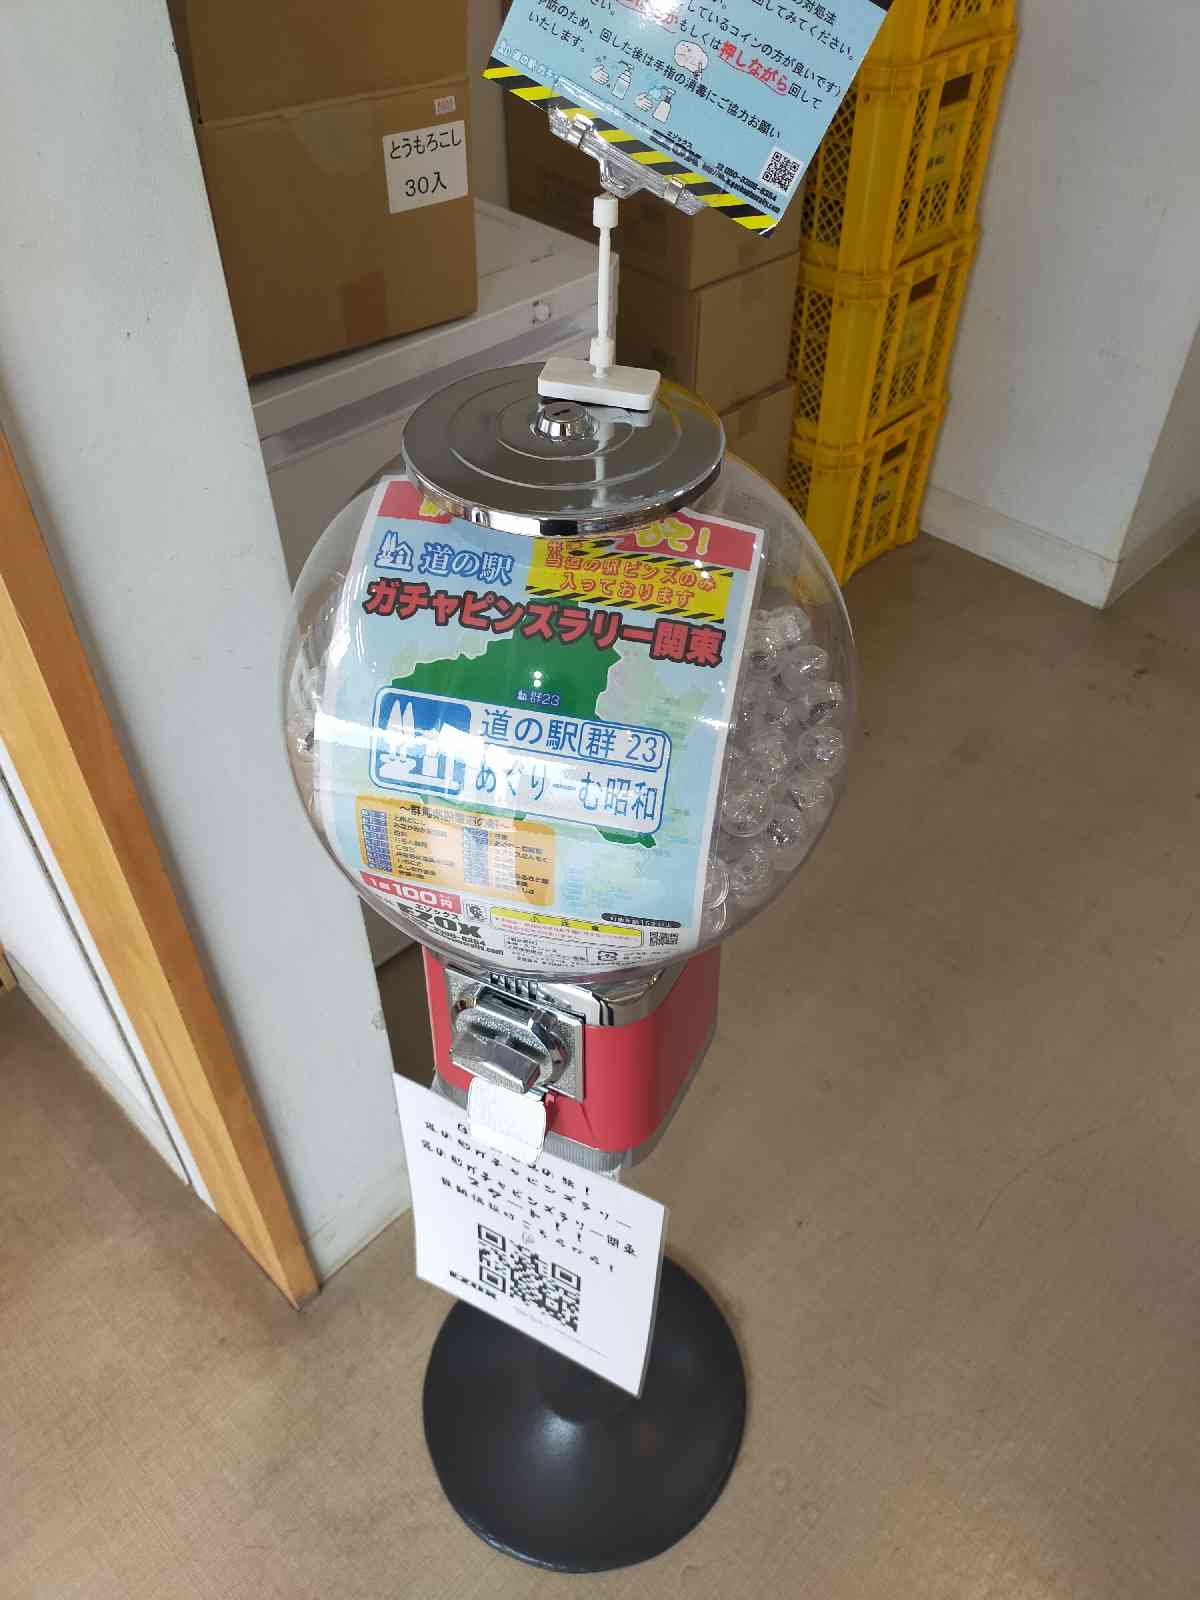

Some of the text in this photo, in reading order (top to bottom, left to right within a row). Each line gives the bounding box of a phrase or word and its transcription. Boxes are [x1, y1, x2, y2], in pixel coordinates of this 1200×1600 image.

[528, 11, 585, 53] いたします。
[390, 127, 462, 160] とうもろこし
[405, 171, 447, 197] 30入
[418, 542, 513, 585] 道の駅
[560, 571, 696, 608] 入っております
[362, 577, 725, 667] ガチャピンズラリー関東
[480, 708, 579, 752] 道の駅
[475, 754, 658, 821] めぐりーむ昭和
